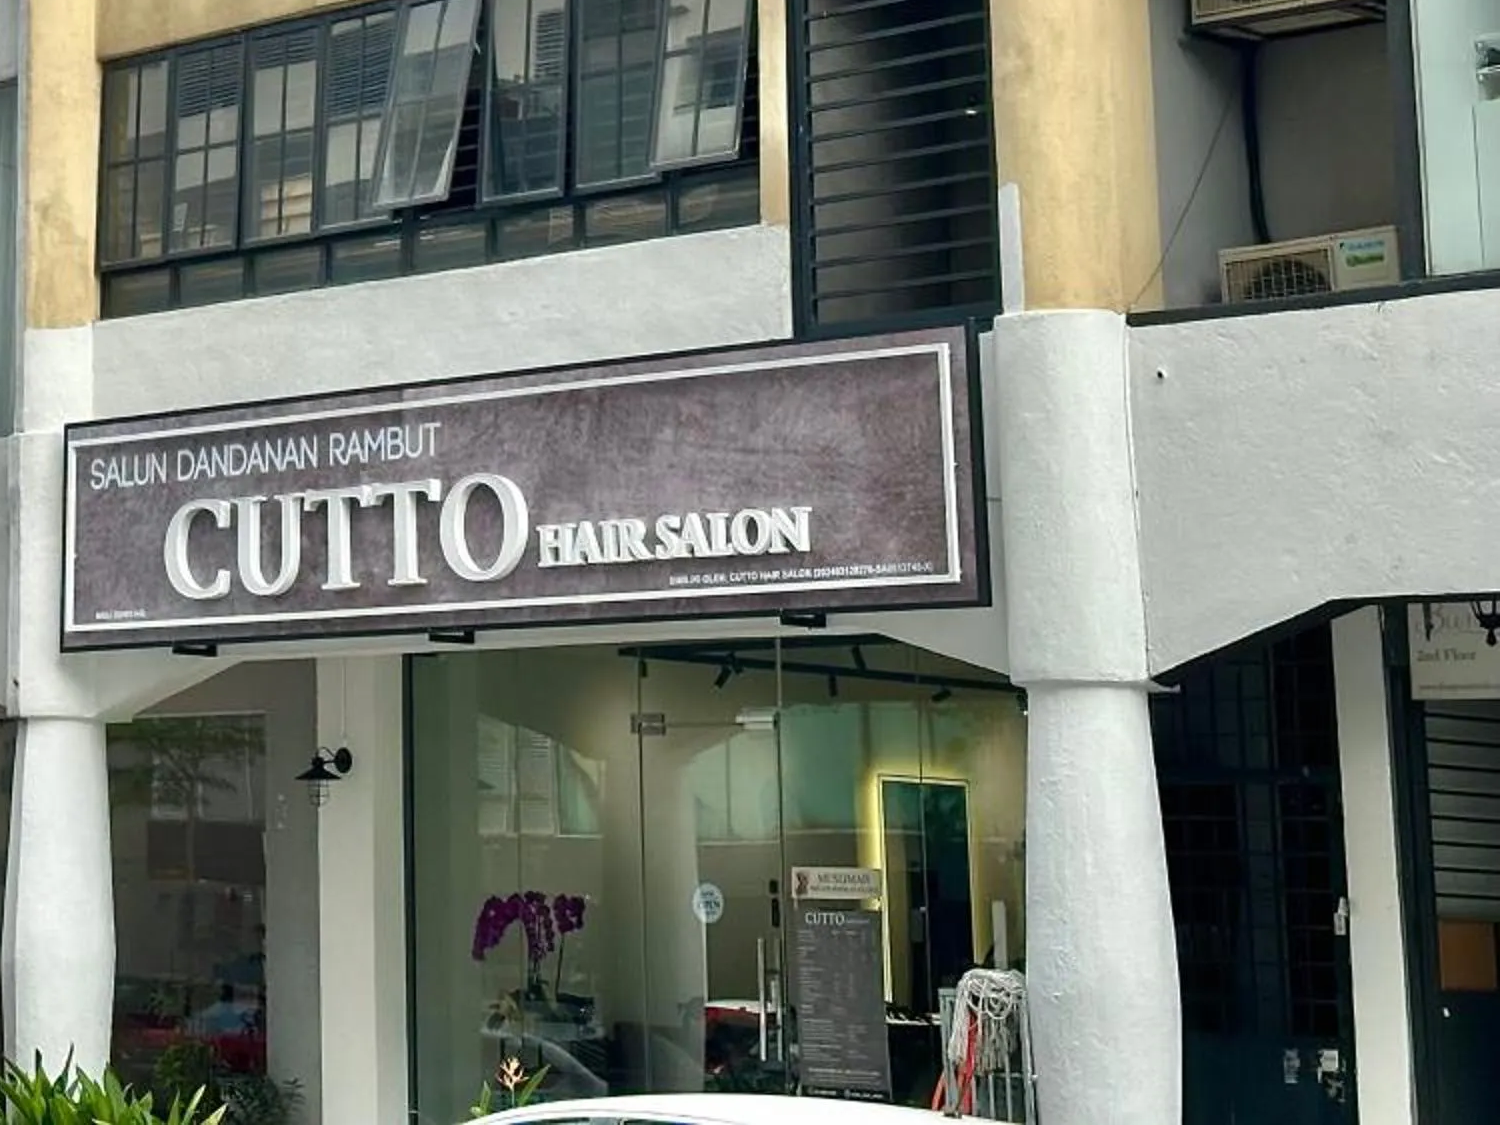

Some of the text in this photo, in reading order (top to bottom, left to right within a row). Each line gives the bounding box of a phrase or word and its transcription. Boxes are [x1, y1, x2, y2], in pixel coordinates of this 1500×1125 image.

[90, 422, 442, 491] SALUN DANDANAN RAMBUT
[163, 472, 813, 602] CUTTO HAIR SALON
[804, 911, 845, 925] CUTTO
